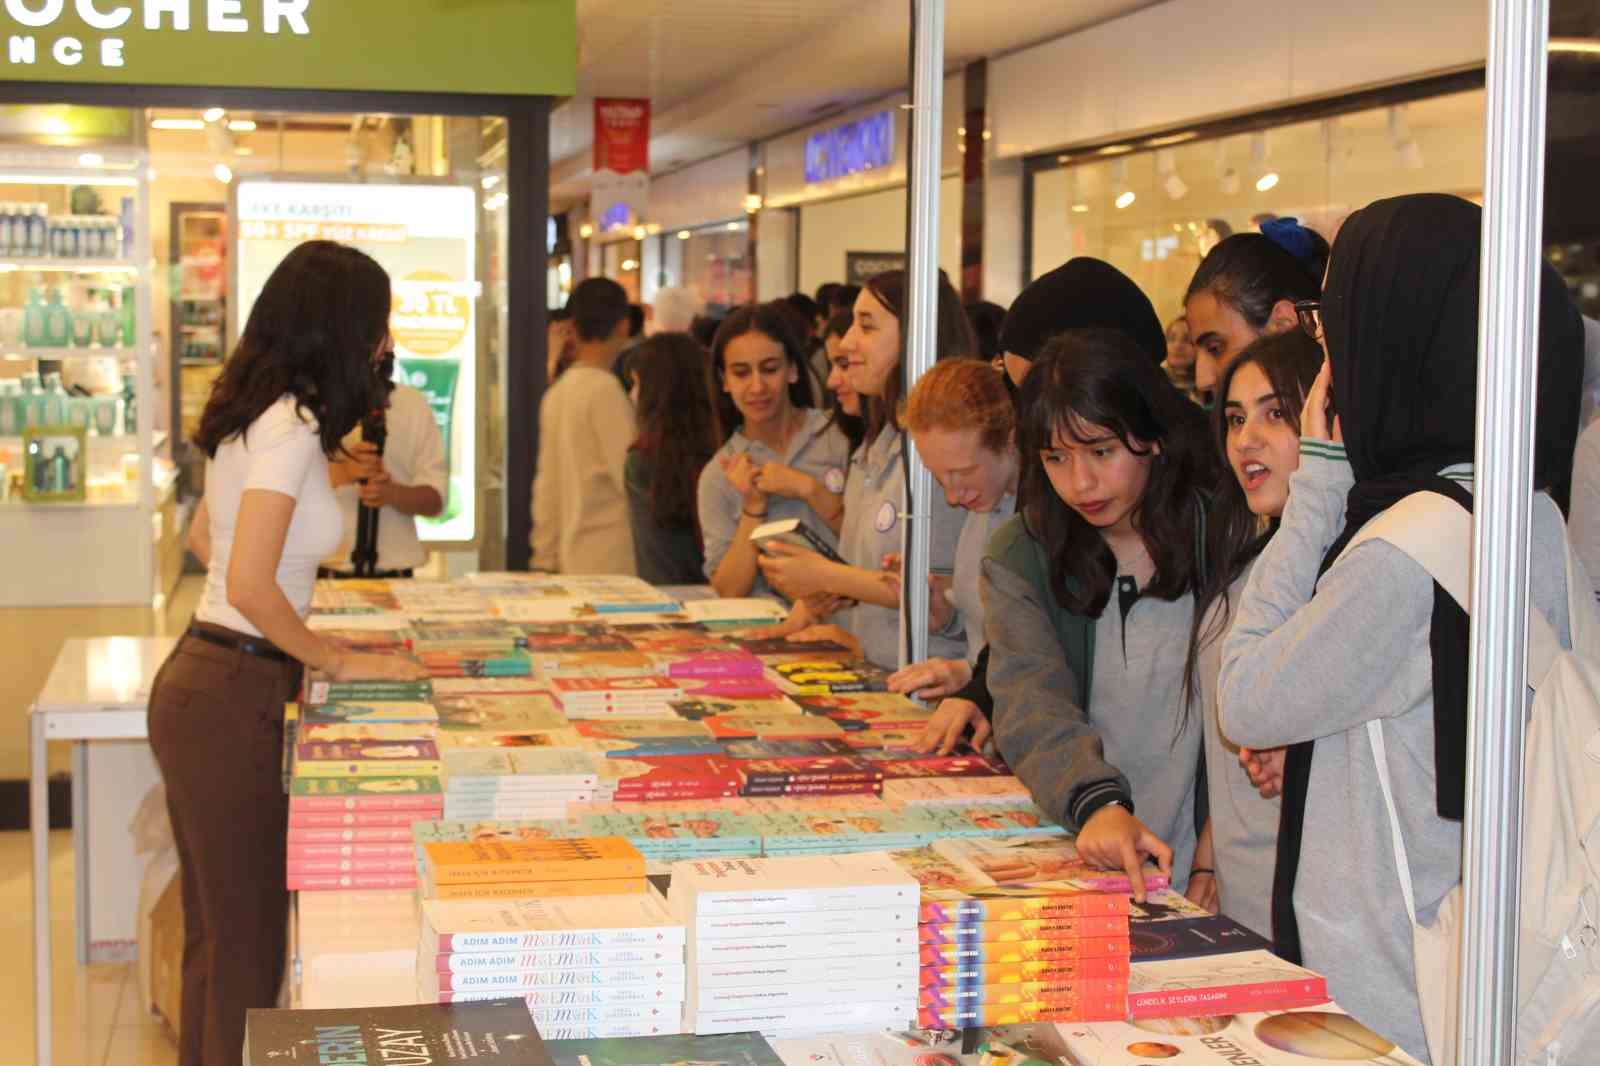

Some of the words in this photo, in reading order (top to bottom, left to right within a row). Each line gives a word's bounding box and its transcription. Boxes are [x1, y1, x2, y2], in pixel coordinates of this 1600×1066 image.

[8, 35, 125, 67] NCE
[463, 937, 490, 946] ADIM
[491, 936, 518, 946] ADIM
[459, 958, 487, 967] ADIM
[489, 956, 516, 966] ADIM
[461, 976, 489, 985] ADIM
[491, 975, 518, 984] ADIM
[375, 1028, 433, 1066] UZAY
